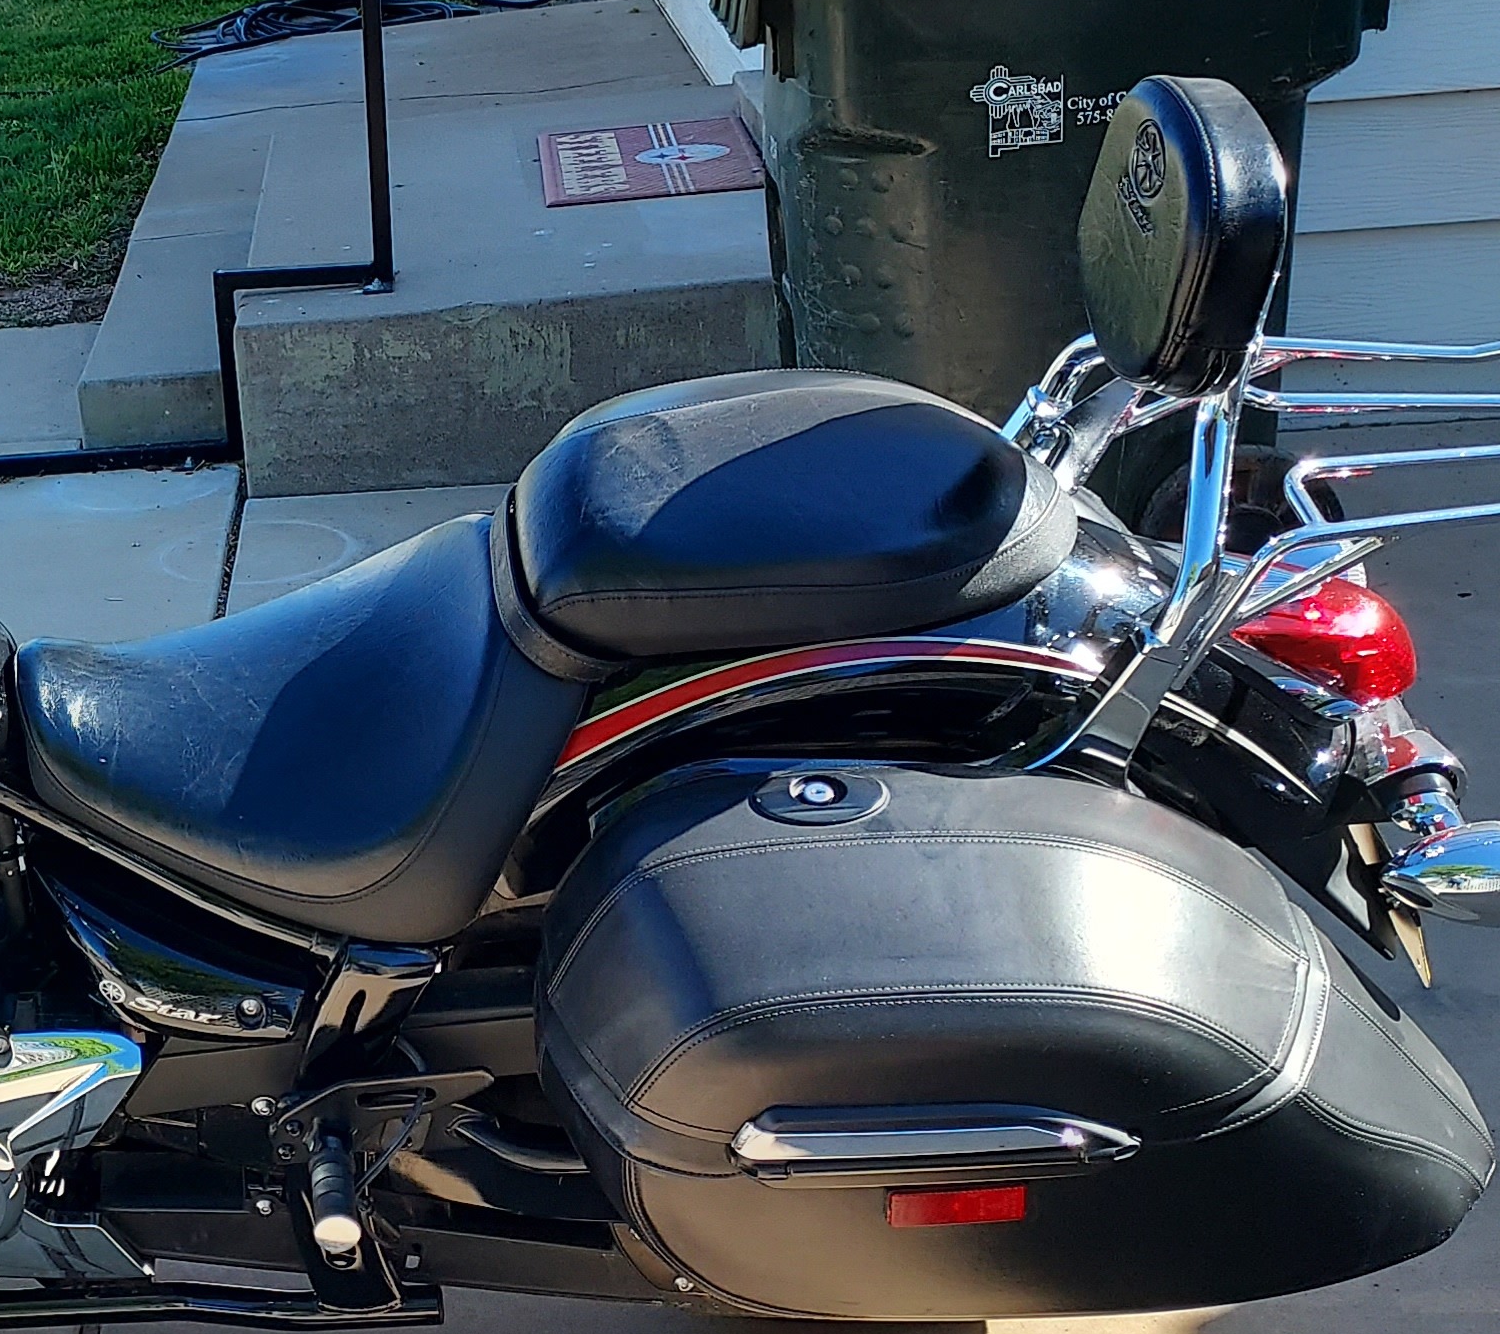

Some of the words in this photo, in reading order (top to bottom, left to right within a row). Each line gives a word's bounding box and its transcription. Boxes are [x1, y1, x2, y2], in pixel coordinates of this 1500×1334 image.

[989, 82, 1061, 101] CARLSBAD
[1067, 96, 1096, 110] City
[1099, 92, 1115, 107] of
